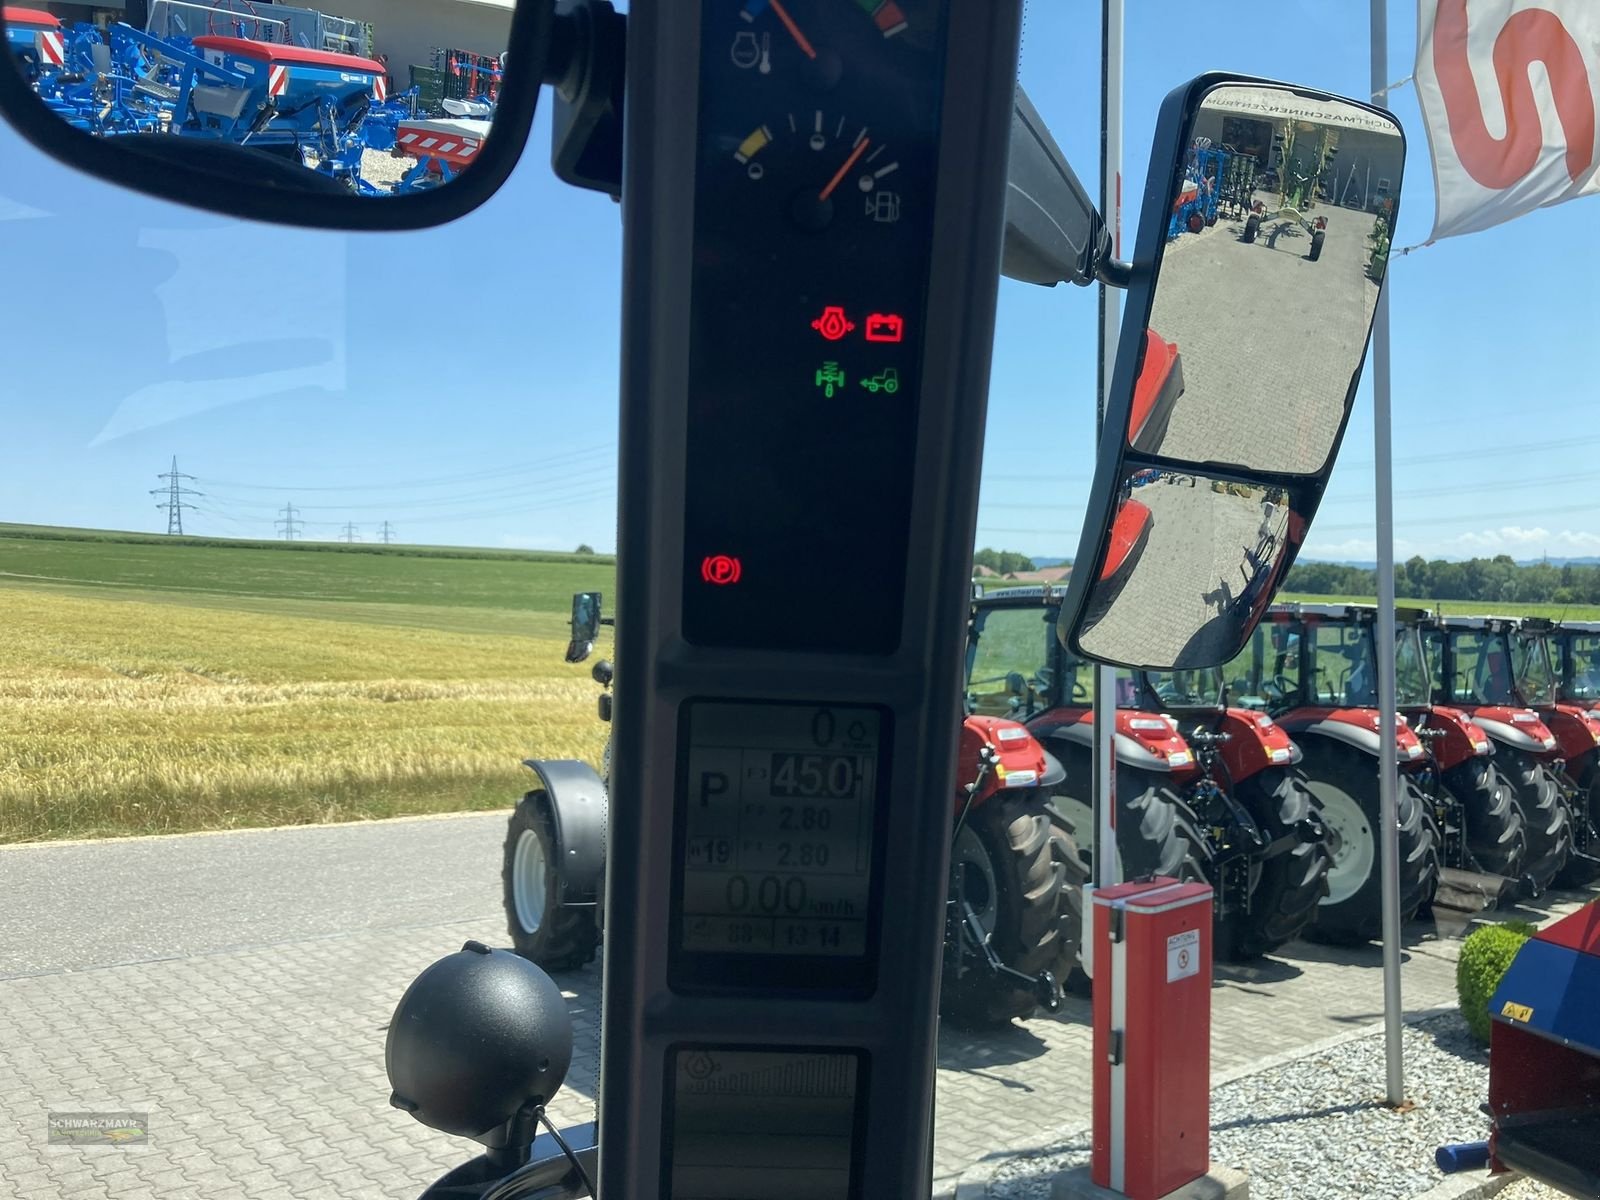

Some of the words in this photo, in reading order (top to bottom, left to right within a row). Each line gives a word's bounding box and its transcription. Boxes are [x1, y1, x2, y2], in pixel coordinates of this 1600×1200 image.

[700, 771, 729, 808] P
[779, 806, 831, 830] 2.80
[777, 842, 829, 867] 2.80
